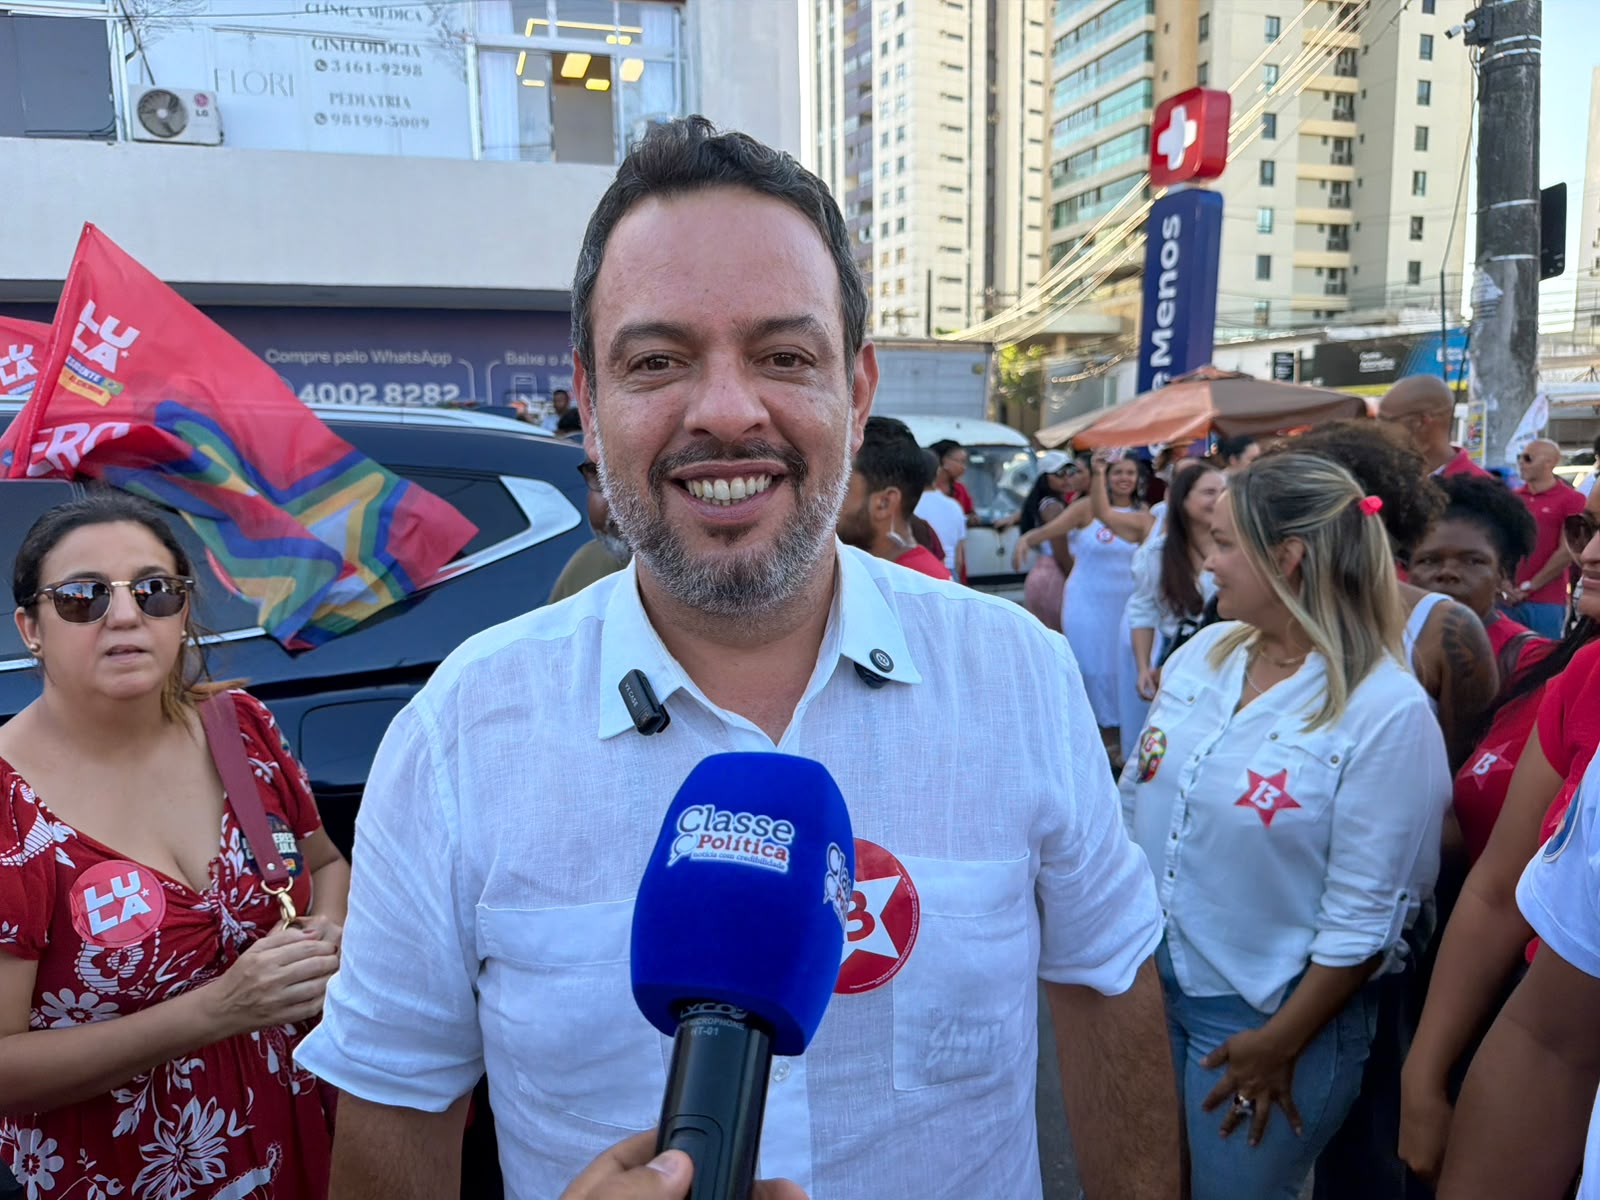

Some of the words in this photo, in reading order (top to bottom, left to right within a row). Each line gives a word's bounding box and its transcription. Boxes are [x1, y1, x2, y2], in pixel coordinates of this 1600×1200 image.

[1150, 214, 1182, 367] Menos
[265, 348, 331, 365] Compre
[335, 349, 368, 366] pelo
[370, 349, 453, 368] WhatsApp
[504, 351, 546, 366] Baixe
[298, 382, 377, 405] 4002
[384, 381, 460, 406] 8282
[1472, 752, 1498, 775] 13
[1249, 780, 1283, 810] 13
[678, 806, 794, 843] Classe
[696, 833, 788, 862] Política
